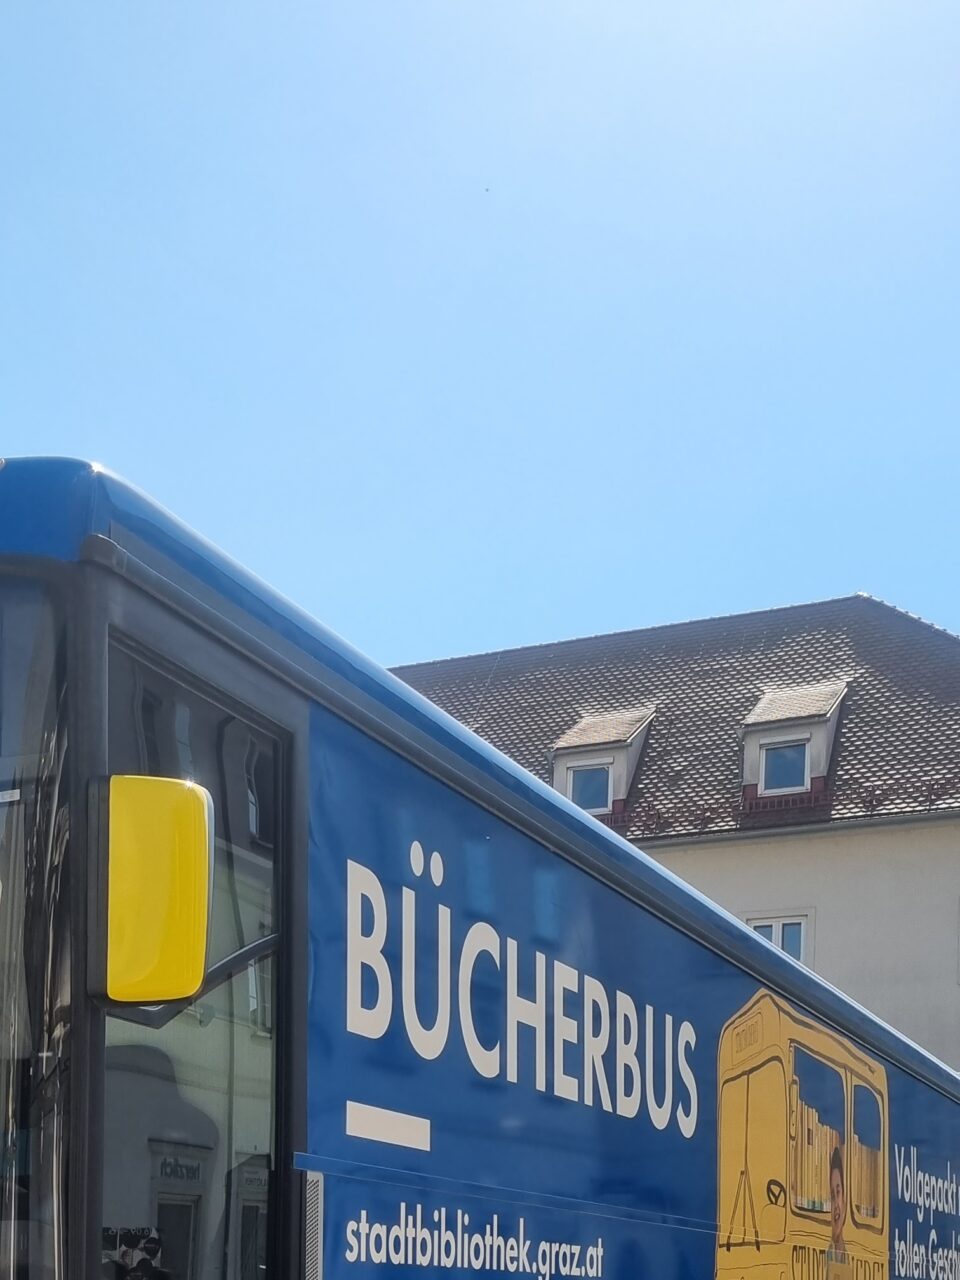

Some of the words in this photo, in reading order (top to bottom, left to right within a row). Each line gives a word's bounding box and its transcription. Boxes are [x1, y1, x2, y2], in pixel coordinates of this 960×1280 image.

[346, 840, 698, 1139] BÜCHERBUS
[894, 1143, 956, 1226] Vollgepackt
[894, 1219, 926, 1279] tollen
